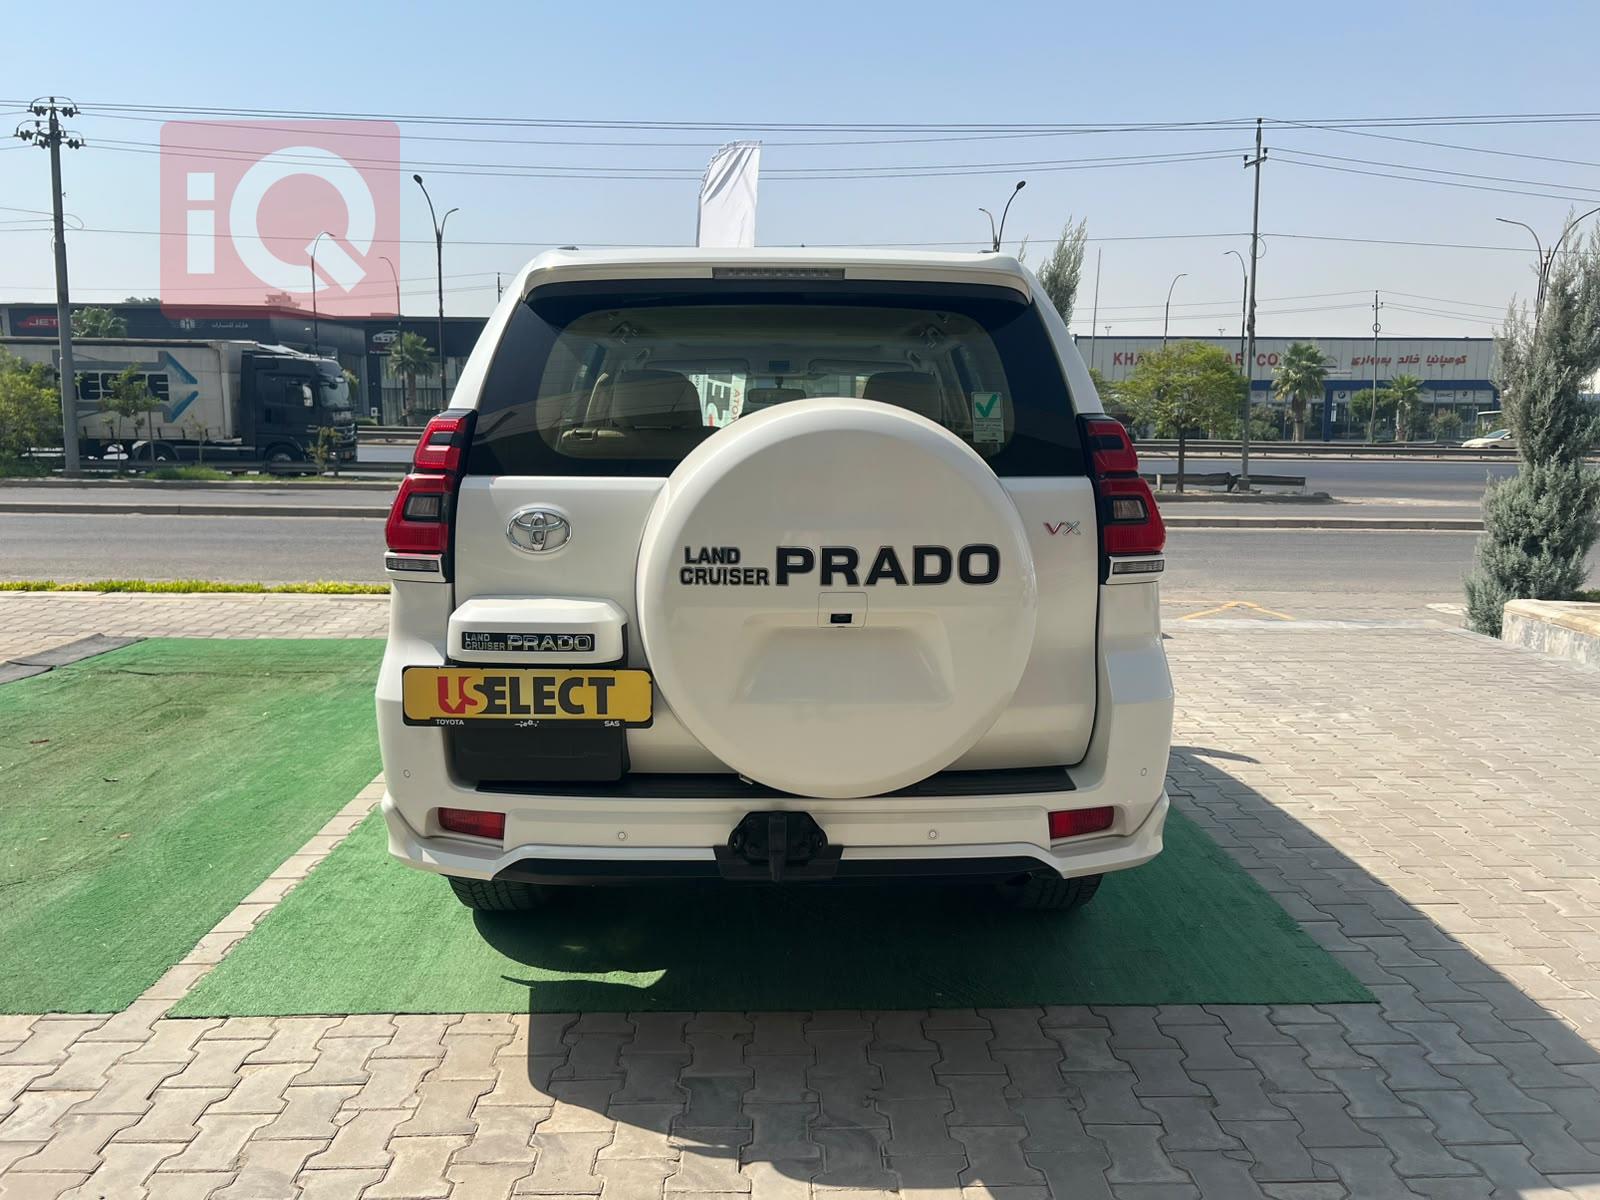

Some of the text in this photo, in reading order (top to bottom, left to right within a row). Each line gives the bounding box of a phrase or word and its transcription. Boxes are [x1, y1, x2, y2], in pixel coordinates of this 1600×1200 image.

[29, 318, 59, 326] JET
[1113, 352, 1145, 366] KHA
[1043, 520, 1081, 535] VX
[684, 546, 741, 565] LAND
[680, 544, 1001, 587] CRUISER PRADO
[464, 634, 592, 651] CRUISER PRADO
[465, 633, 490, 641] LAND
[435, 718, 465, 726] TOYOTA
